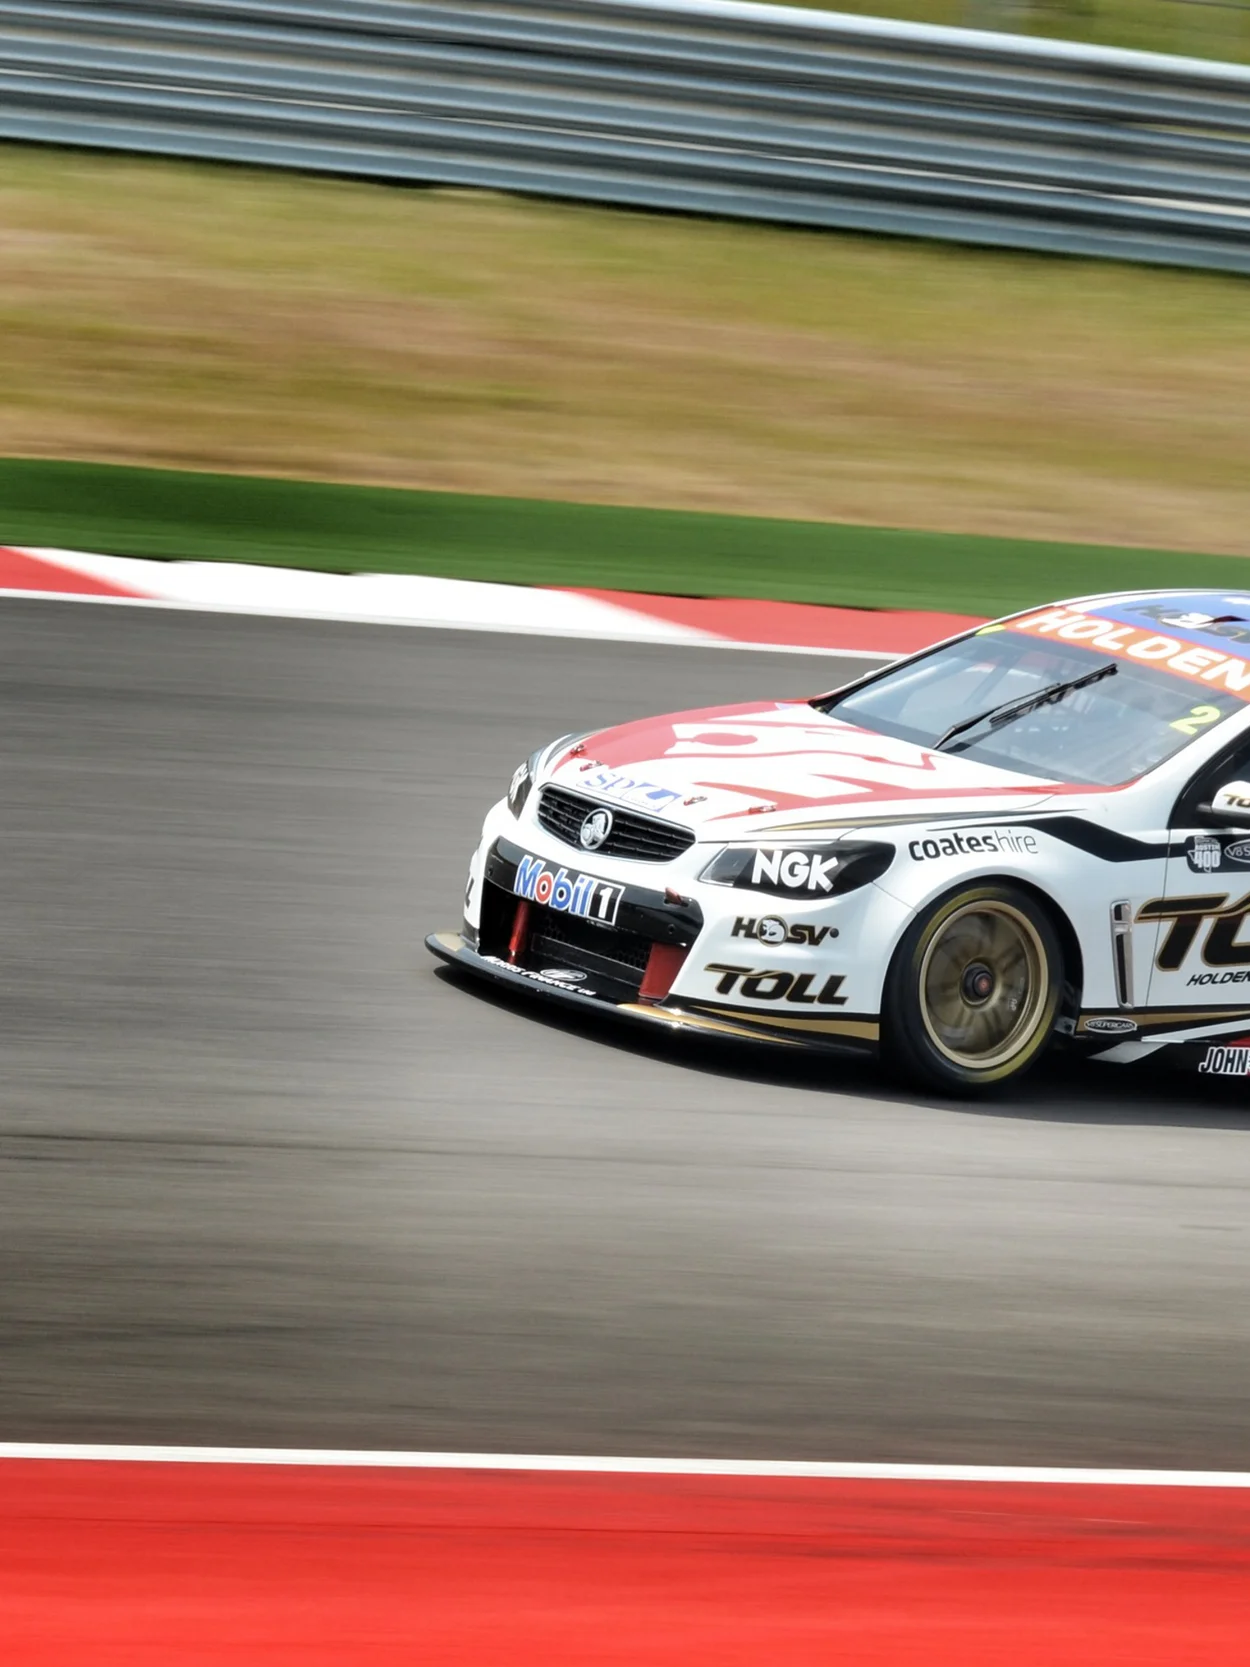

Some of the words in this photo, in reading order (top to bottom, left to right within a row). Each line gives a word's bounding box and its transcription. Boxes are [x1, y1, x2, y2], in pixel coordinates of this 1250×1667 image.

[1169, 705, 1221, 735] 2
[751, 849, 839, 892] NGK
[1194, 851, 1221, 868] 400
[513, 854, 594, 917] Mobil
[597, 886, 614, 919] 1
[703, 963, 849, 1005] TOLL
[1199, 1047, 1249, 1074] JOHN
